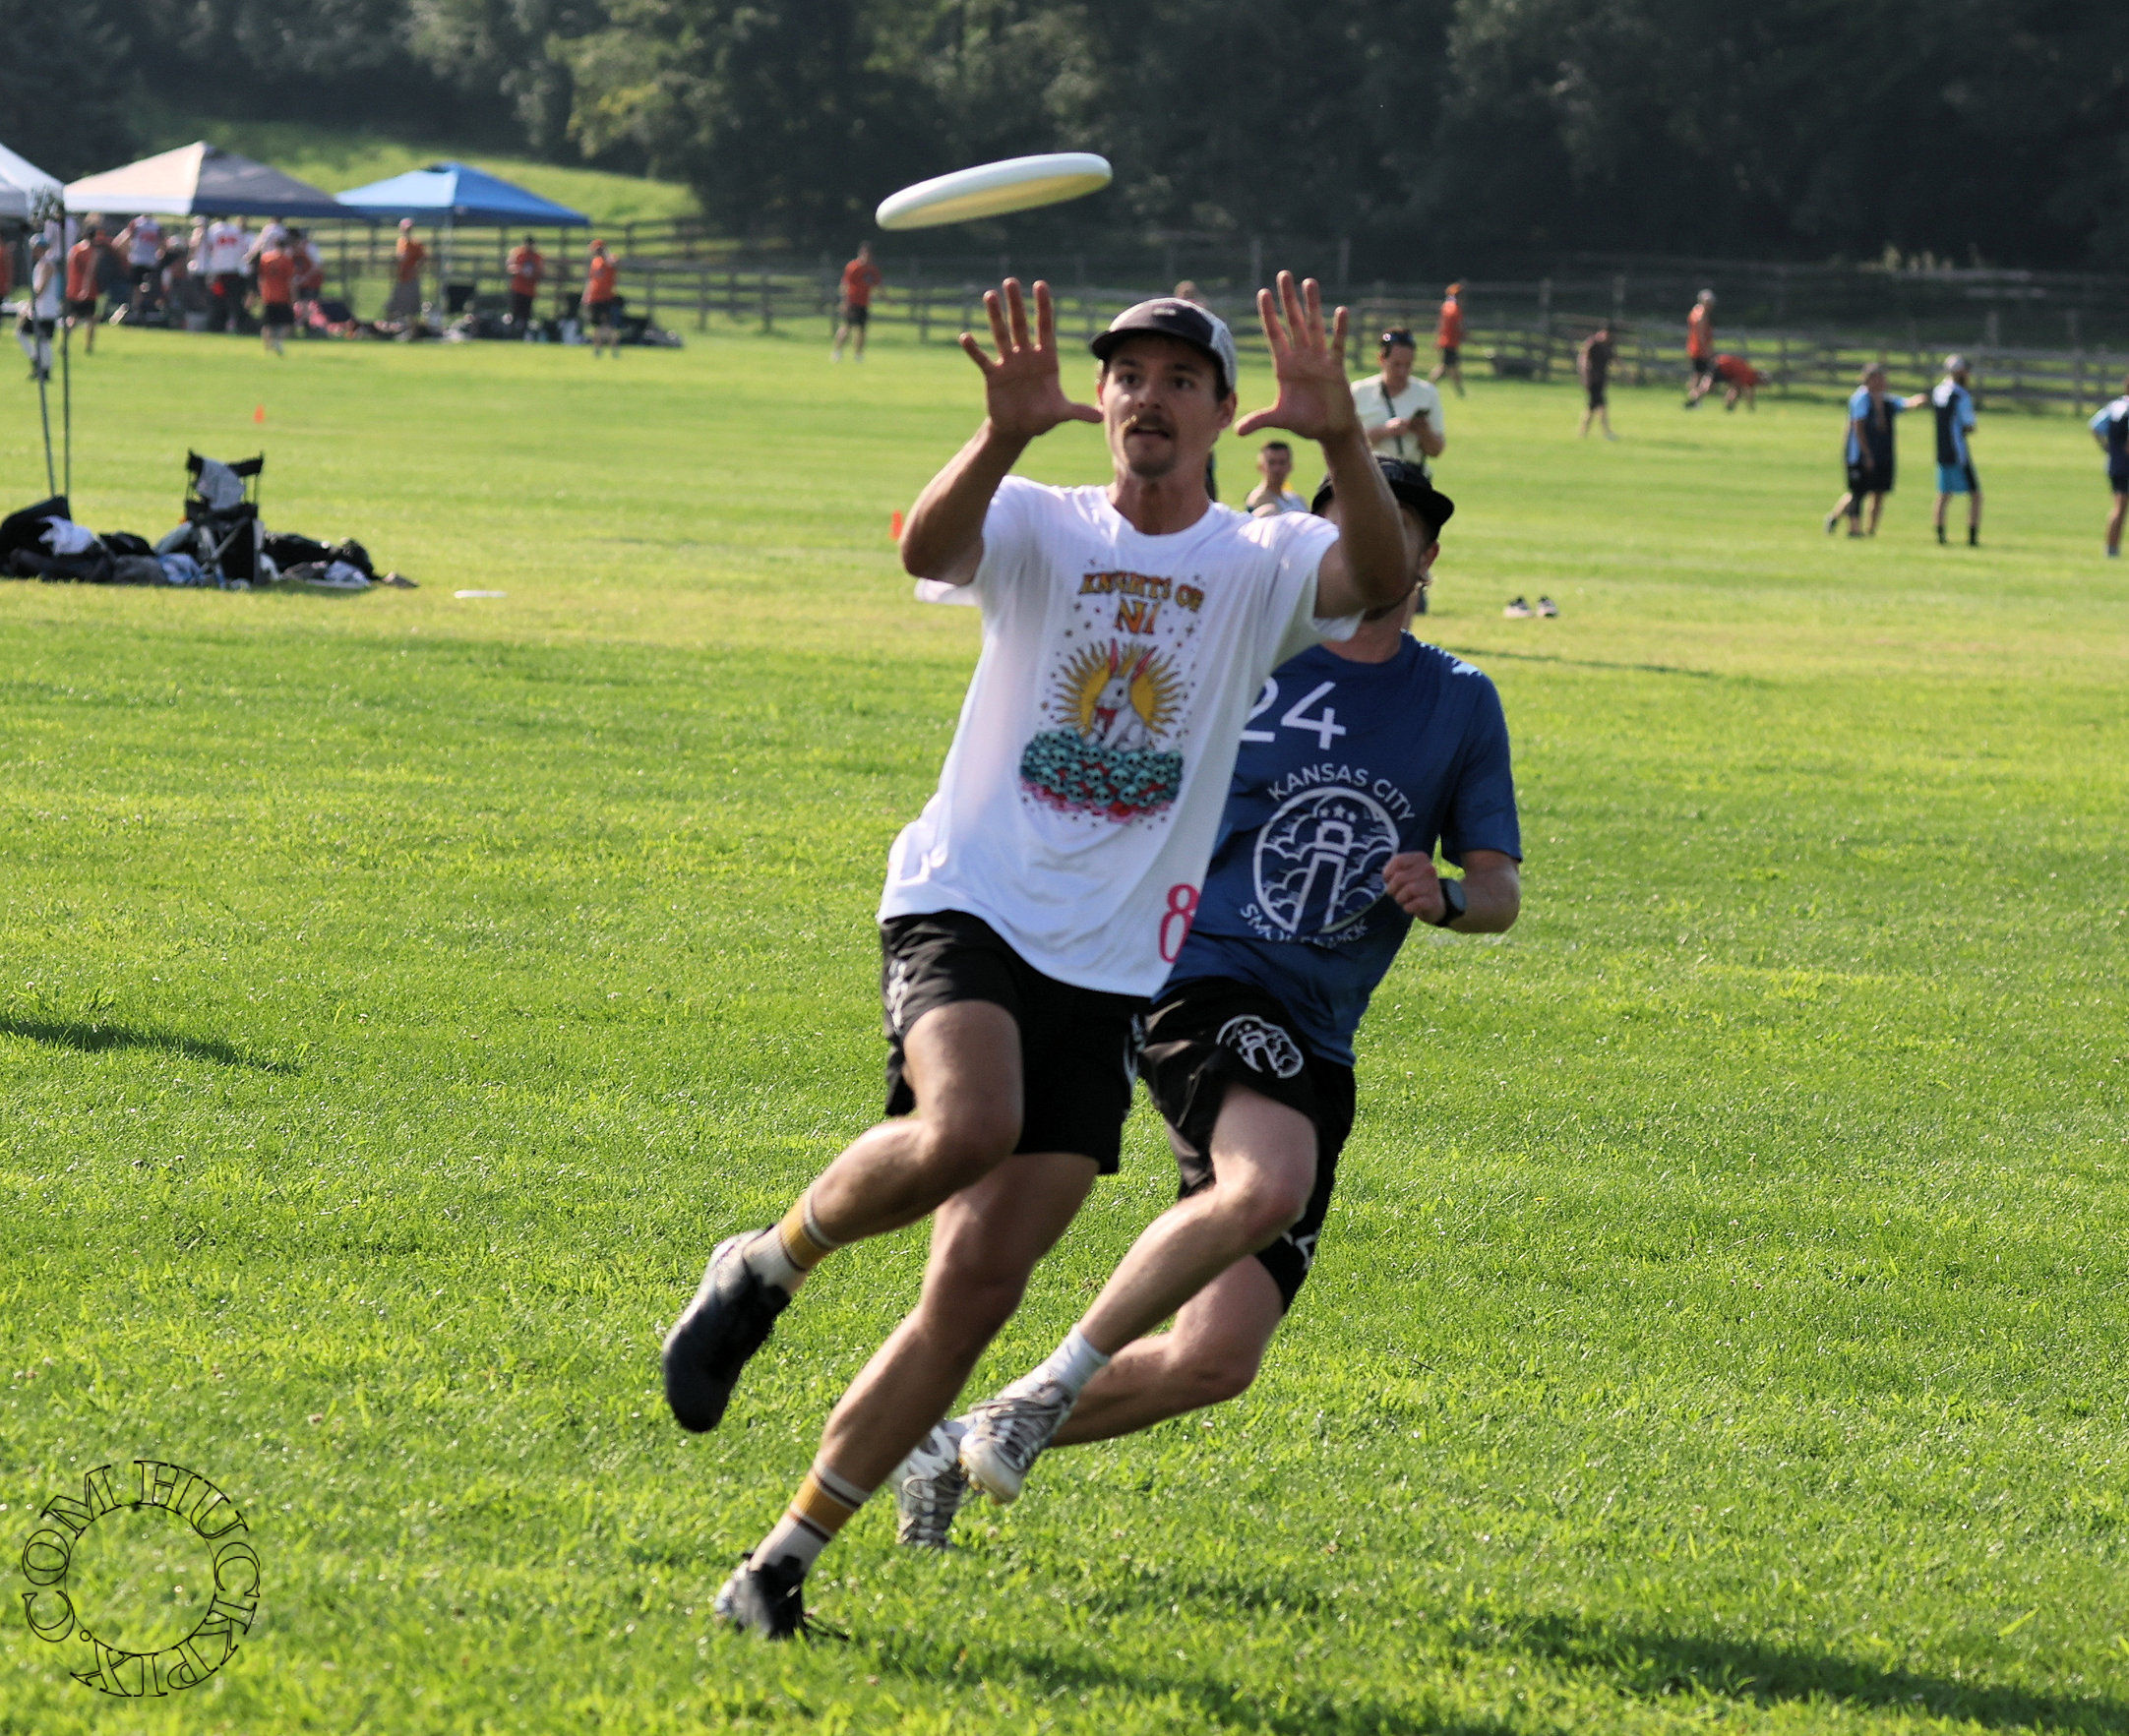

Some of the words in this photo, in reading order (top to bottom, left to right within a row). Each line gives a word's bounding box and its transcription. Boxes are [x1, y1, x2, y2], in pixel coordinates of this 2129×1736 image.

[1113, 596, 1161, 635] NI
[1239, 676, 1347, 750] 24
[1268, 762, 1369, 802] KANSAS
[1371, 778, 1416, 822] CITY
